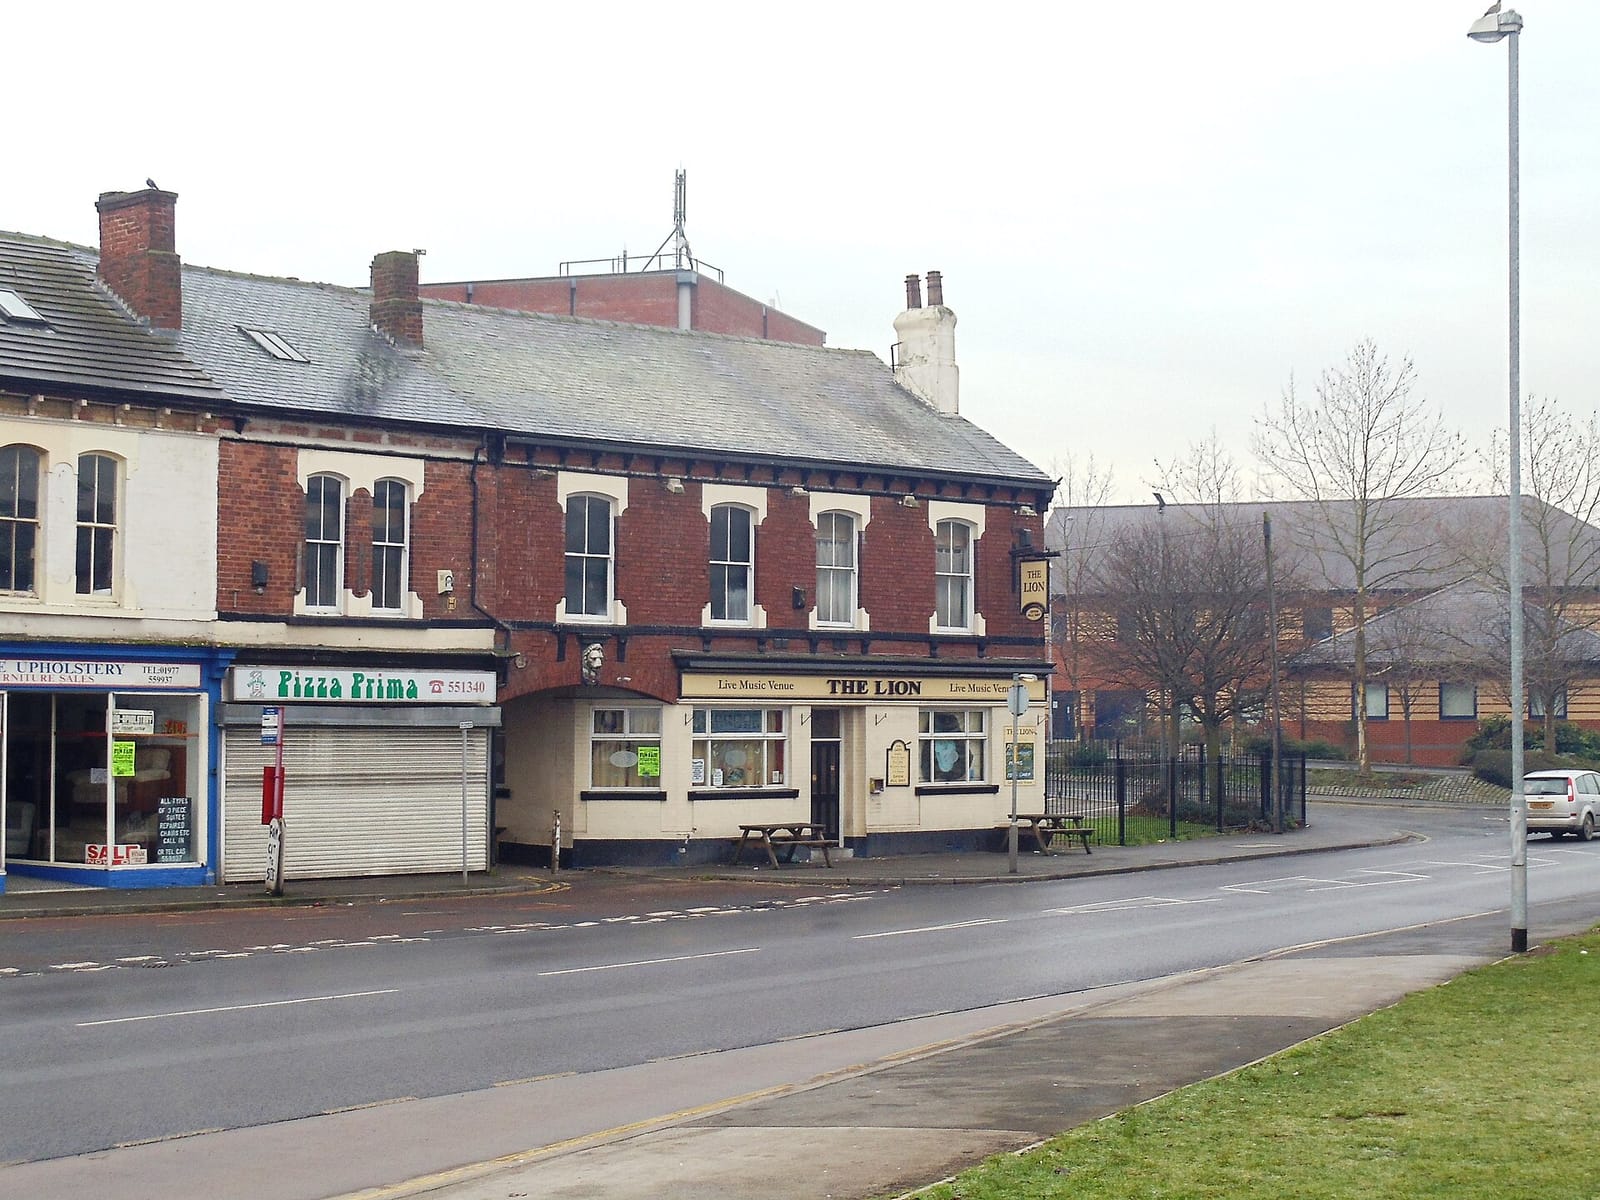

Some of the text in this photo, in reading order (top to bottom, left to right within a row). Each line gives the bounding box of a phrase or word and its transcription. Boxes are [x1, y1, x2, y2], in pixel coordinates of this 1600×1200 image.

[1027, 570, 1041, 579] THE
[1023, 582, 1045, 592] LION
[17, 661, 124, 675] UPHOLSTERY
[60, 674, 95, 683] SALES
[278, 671, 485, 699] Pizza Prima 551340
[718, 680, 794, 690] Live Music Venue
[826, 679, 921, 695] THE LION
[950, 683, 966, 693] Live
[968, 683, 991, 693] Music
